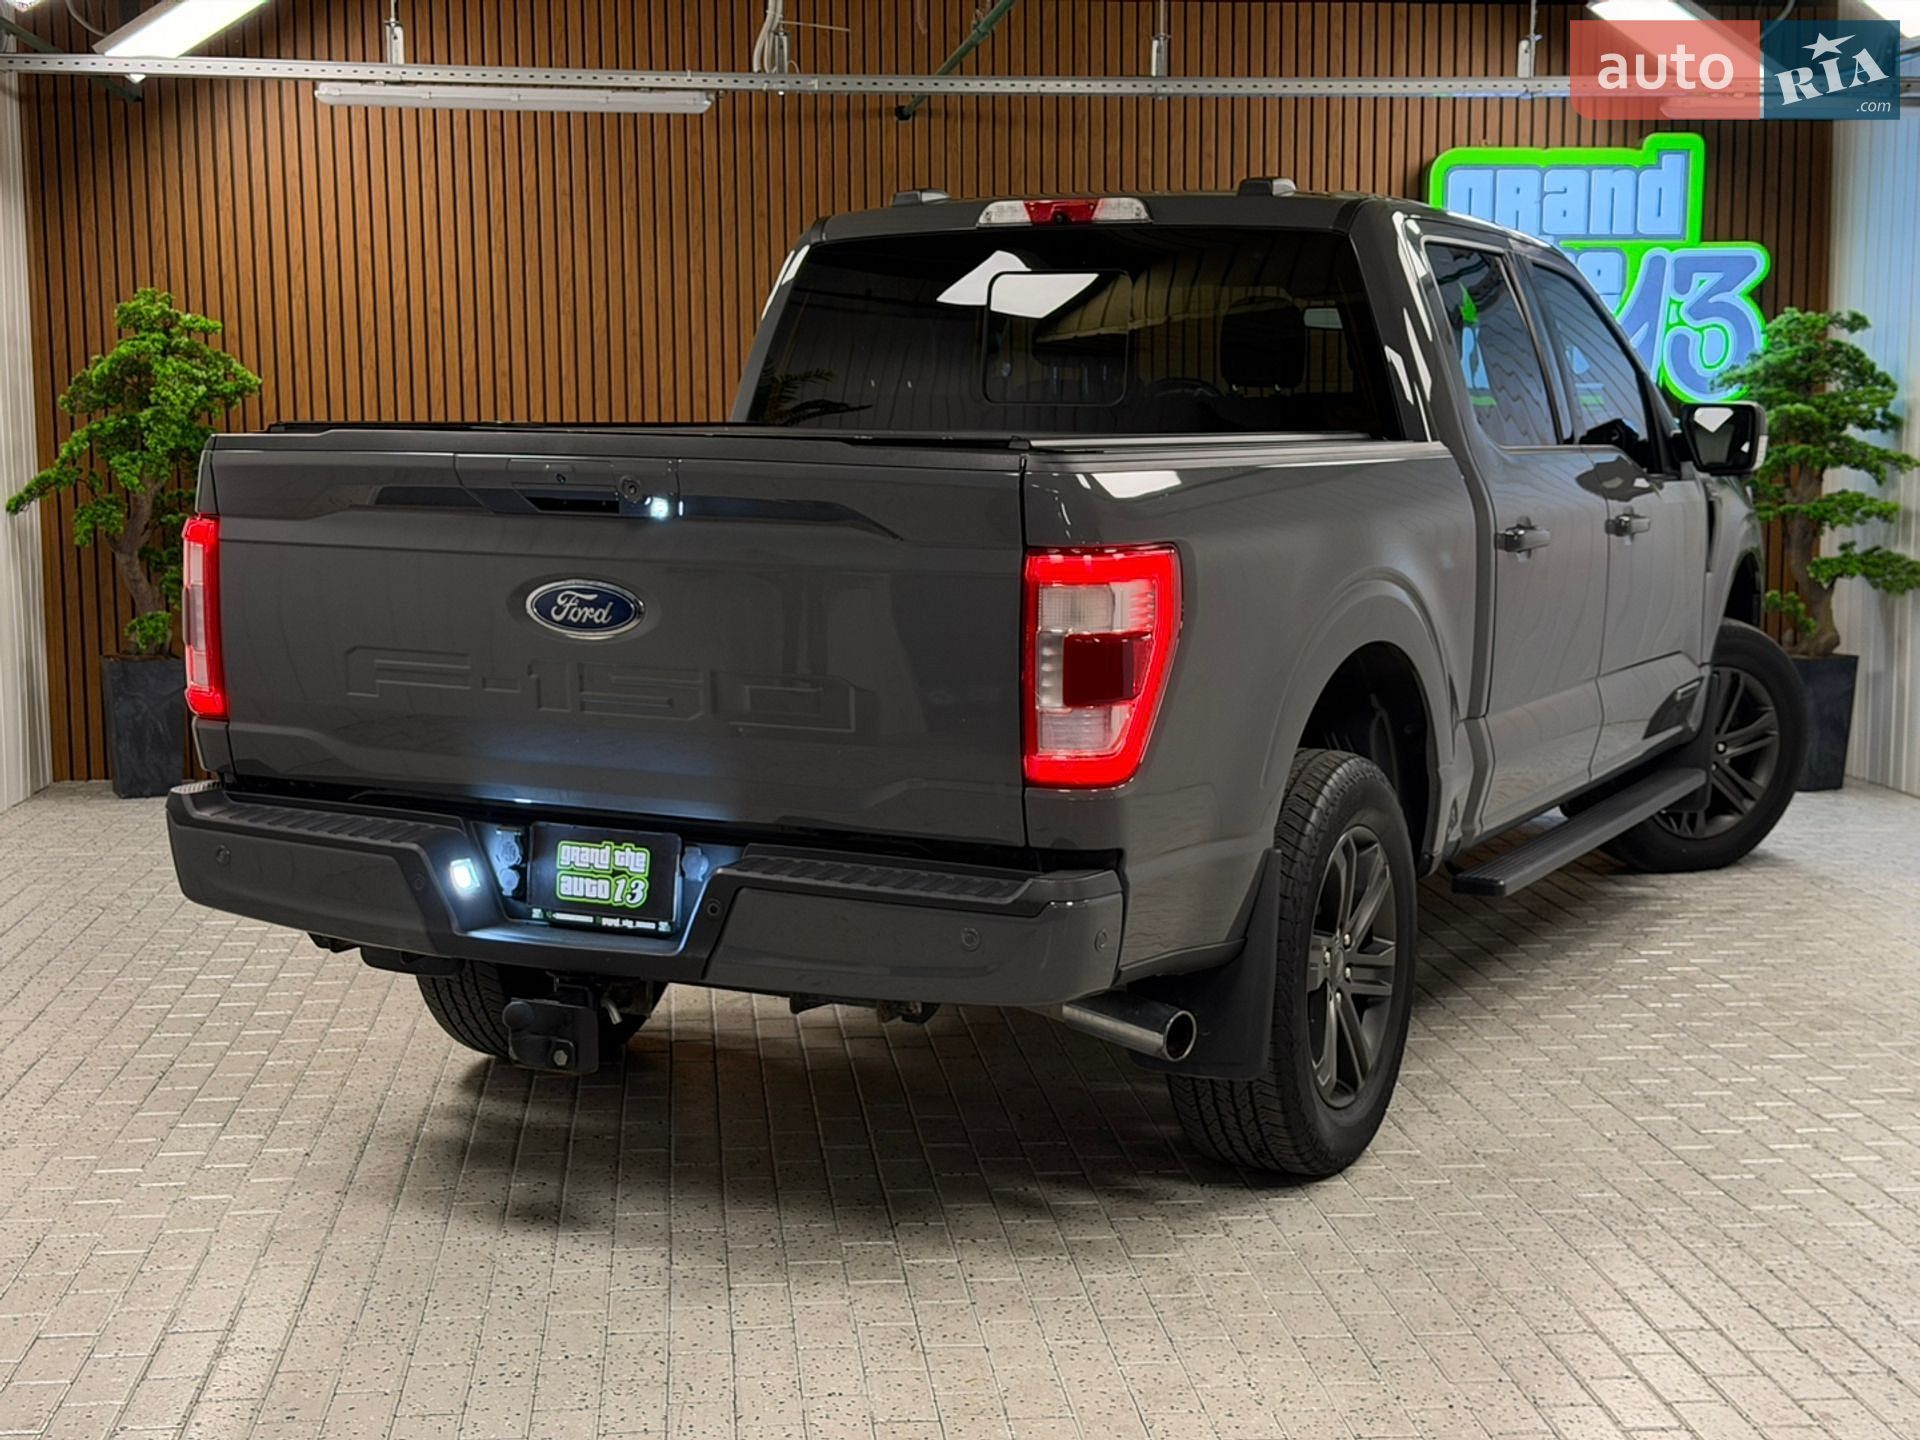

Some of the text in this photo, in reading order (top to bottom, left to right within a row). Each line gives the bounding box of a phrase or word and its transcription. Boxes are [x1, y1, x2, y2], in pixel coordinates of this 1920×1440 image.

[550, 590, 612, 624] Ford
[346, 645, 856, 733] F-150
[614, 846, 647, 873] the
[559, 875, 646, 904] auto 13
